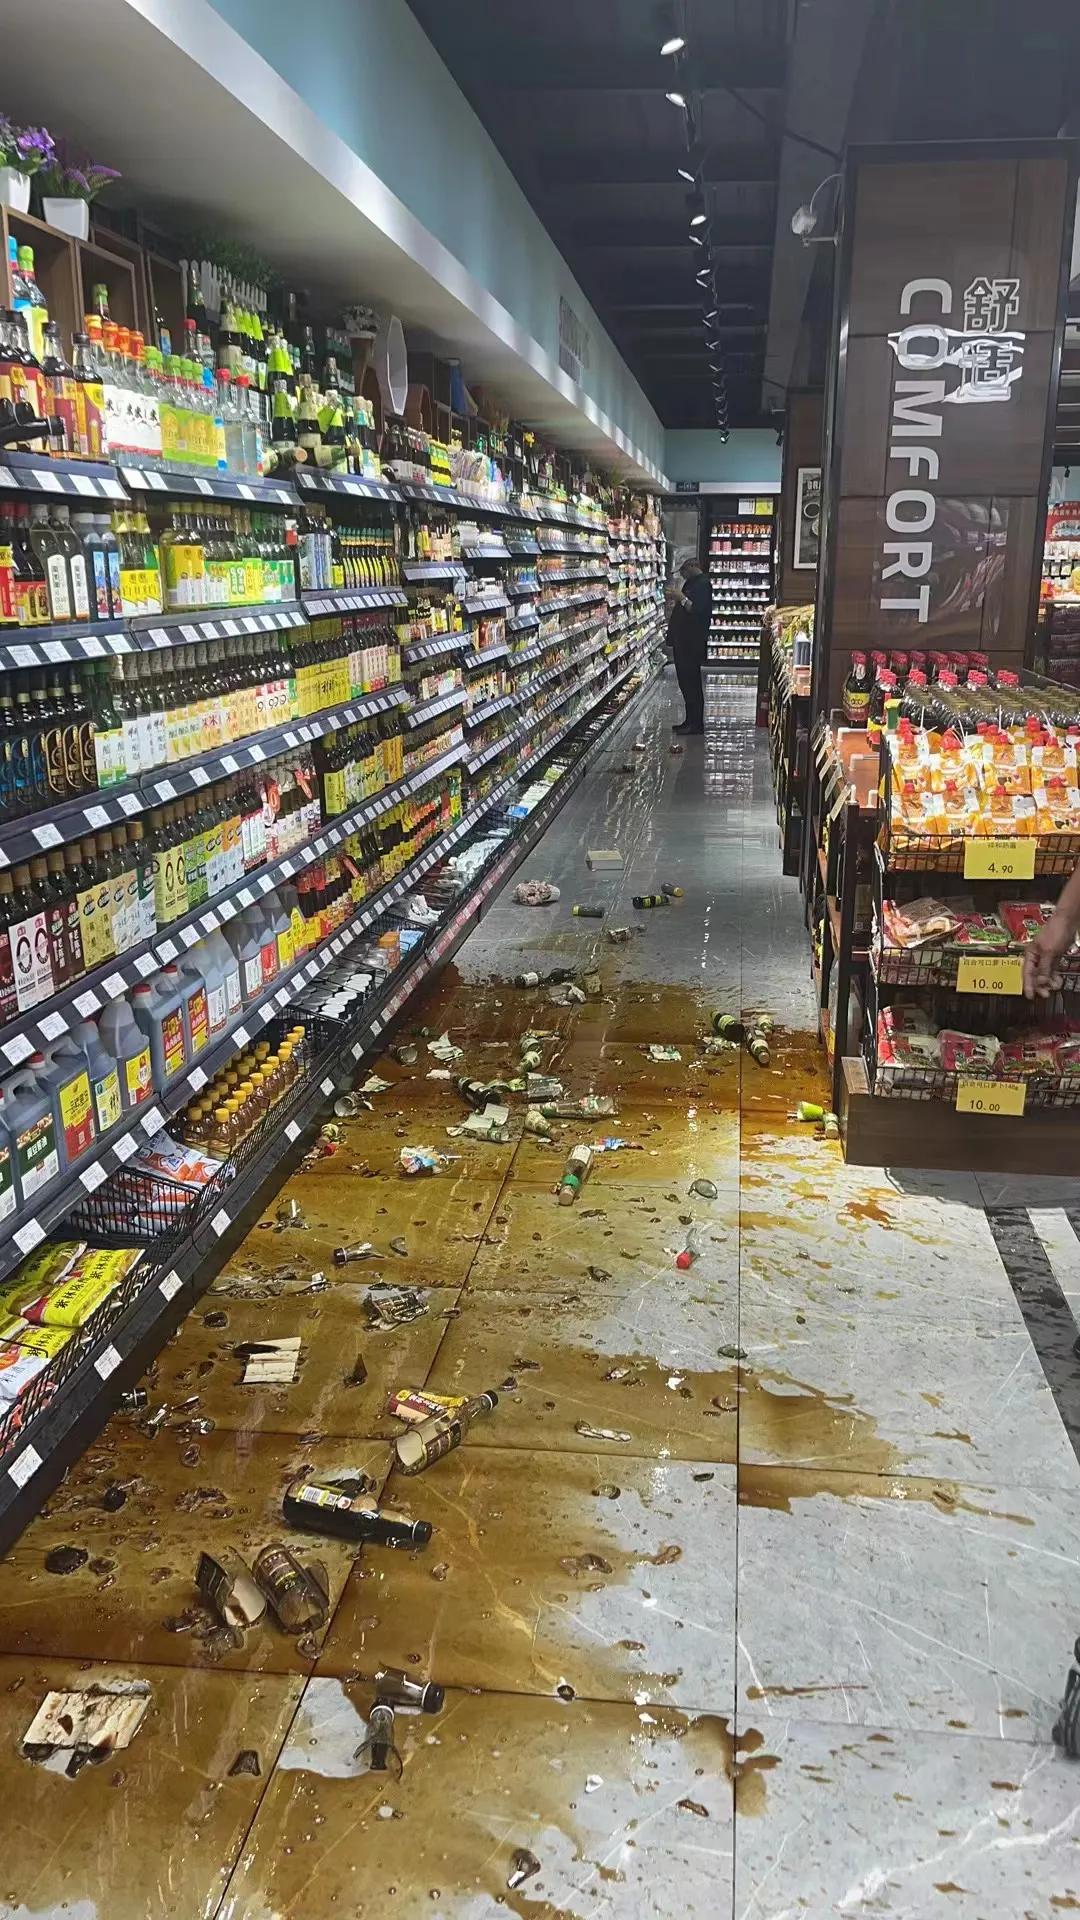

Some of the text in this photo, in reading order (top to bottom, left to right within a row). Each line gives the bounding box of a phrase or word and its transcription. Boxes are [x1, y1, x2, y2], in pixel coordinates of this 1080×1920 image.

[958, 277, 1020, 401] 舒适
[879, 278, 953, 623] COMFORT
[988, 862, 1014, 874] 4.90
[972, 978, 1004, 990] 10.00
[969, 1099, 1001, 1112] 10.00
